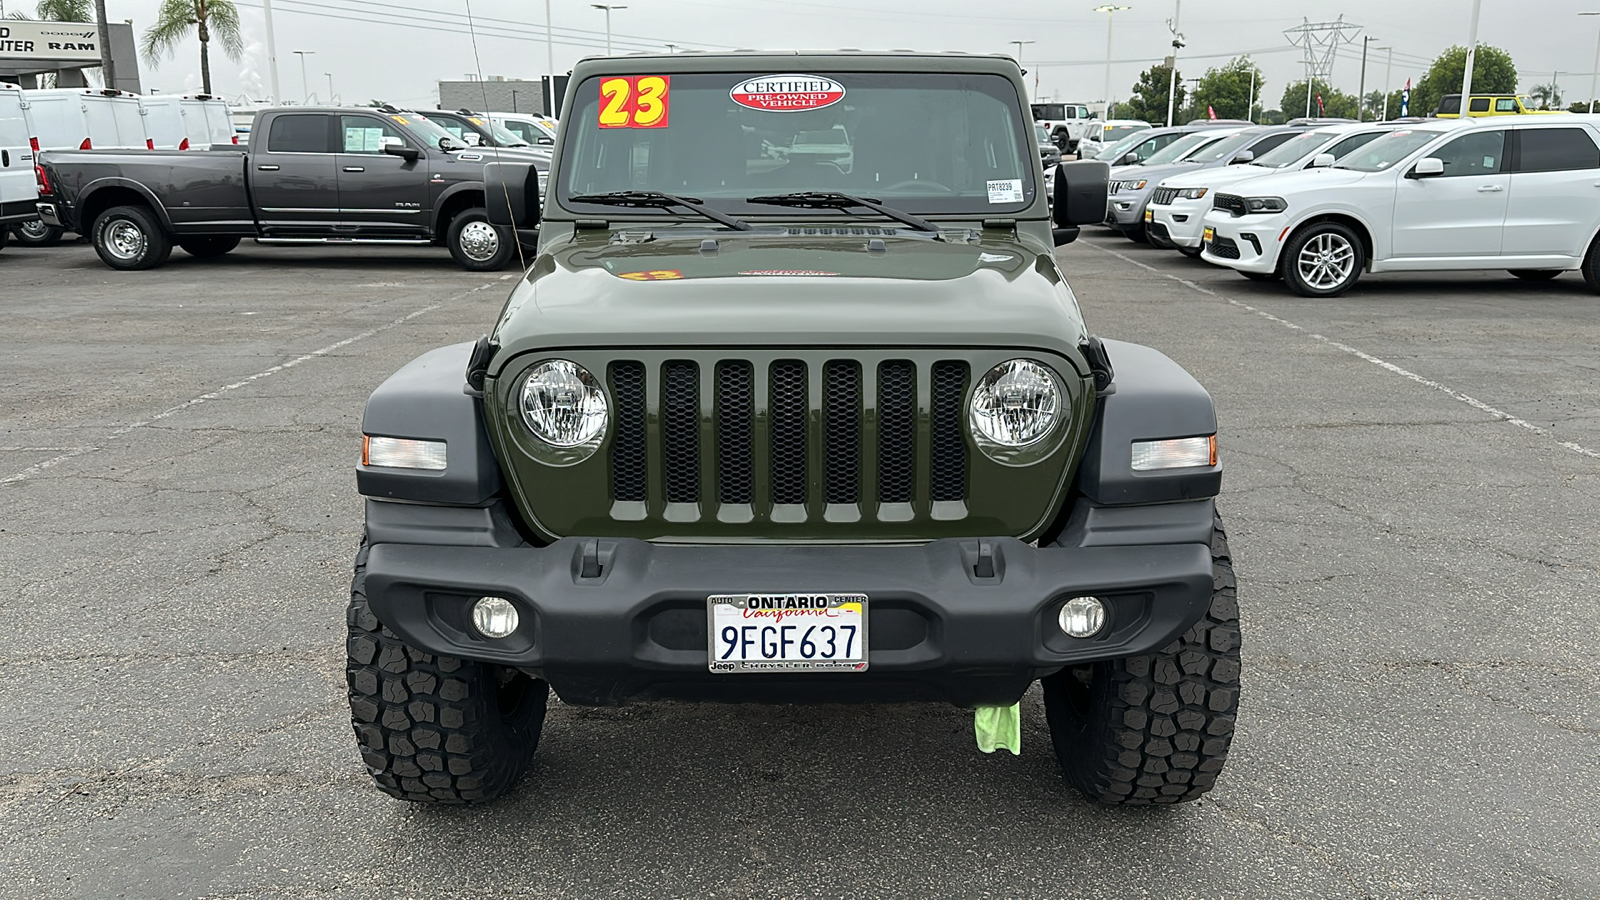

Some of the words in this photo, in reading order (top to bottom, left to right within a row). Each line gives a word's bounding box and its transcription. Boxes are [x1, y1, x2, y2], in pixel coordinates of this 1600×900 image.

[48, 42, 95, 51] RAM
[743, 81, 832, 93] CERTIFIED
[599, 77, 667, 127] 23
[747, 93, 828, 101] PRE-OWNED
[748, 596, 828, 609] ONTARIO
[721, 625, 857, 659] 9FGF637
[710, 662, 735, 672] Jeep
